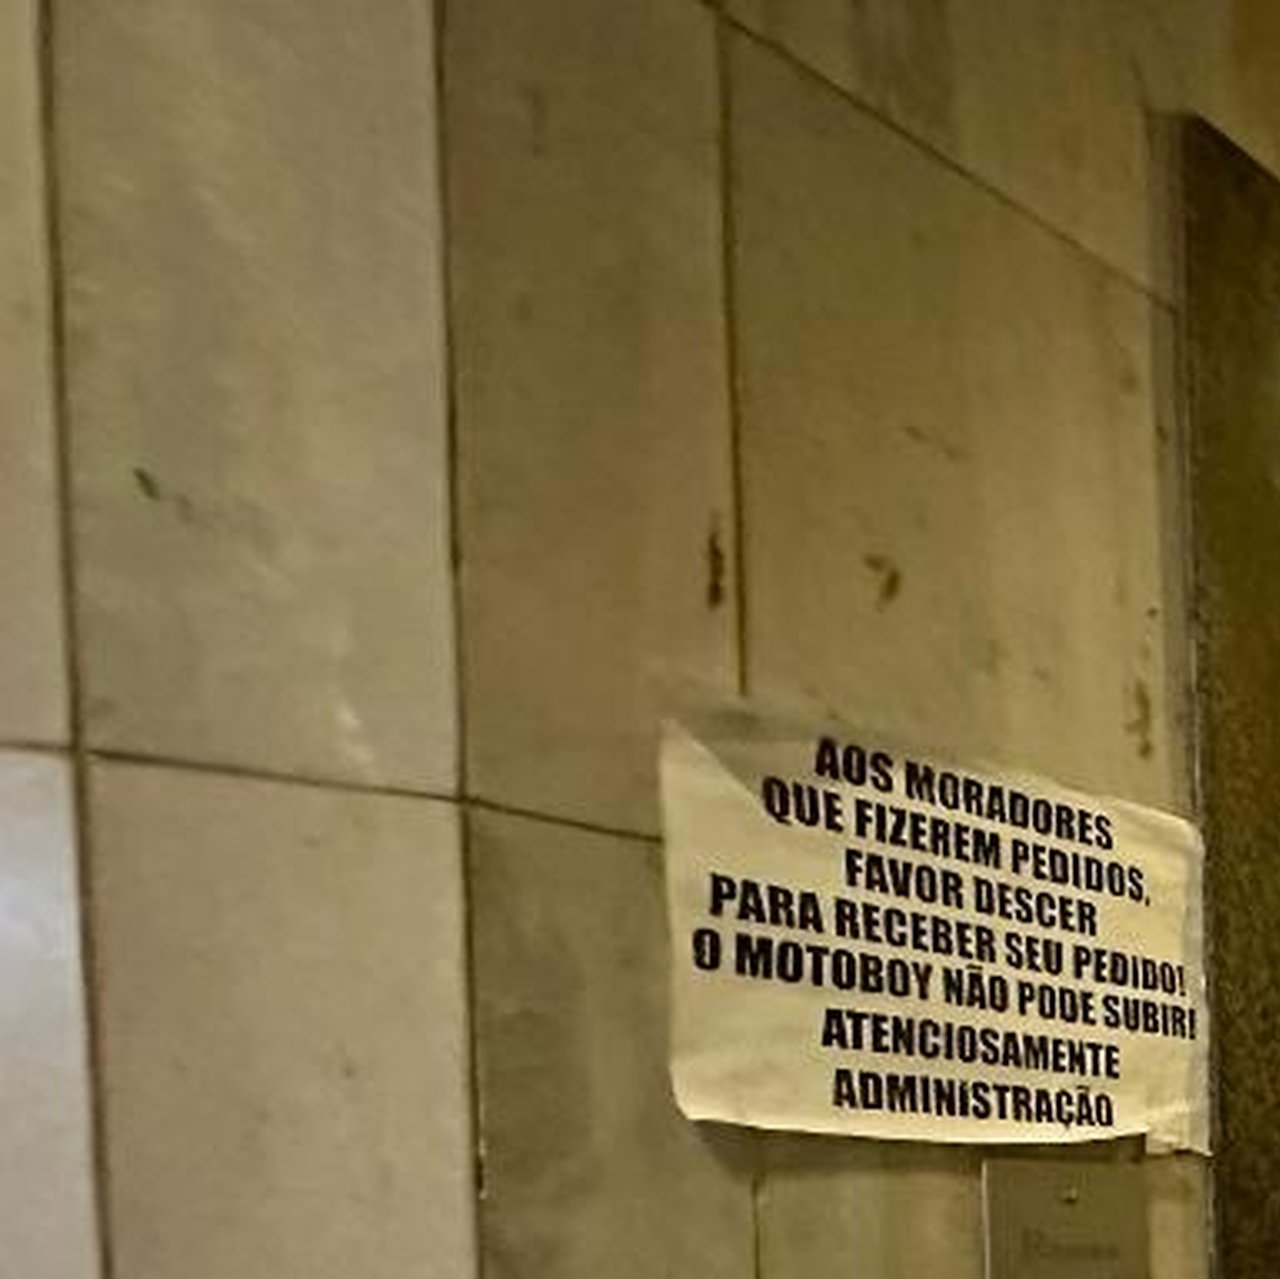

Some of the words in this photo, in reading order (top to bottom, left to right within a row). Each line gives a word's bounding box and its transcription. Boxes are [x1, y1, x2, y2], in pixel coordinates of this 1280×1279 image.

[762, 777, 843, 832] QUE
[855, 801, 1001, 869] FIZEREM
[816, 735, 894, 791] AOS
[905, 761, 1114, 850] MORADORES
[710, 872, 824, 932] PARA
[835, 898, 996, 963] RECEBER
[1005, 932, 1063, 975] SEU
[1074, 947, 1185, 996] PEDIDO!
[845, 848, 964, 910] FAVOR
[974, 876, 1097, 935] DESCER
[692, 928, 720, 970] O
[736, 932, 932, 1000] MOTOBOY
[942, 965, 1009, 1012] NÃO
[1017, 982, 1095, 1025] PODE
[1104, 995, 1196, 1039] SUBIR!
[821, 1009, 1120, 1079] ATENCIOSAMENTE
[832, 1069, 1114, 1130] ADMINISTRAÇÃO
